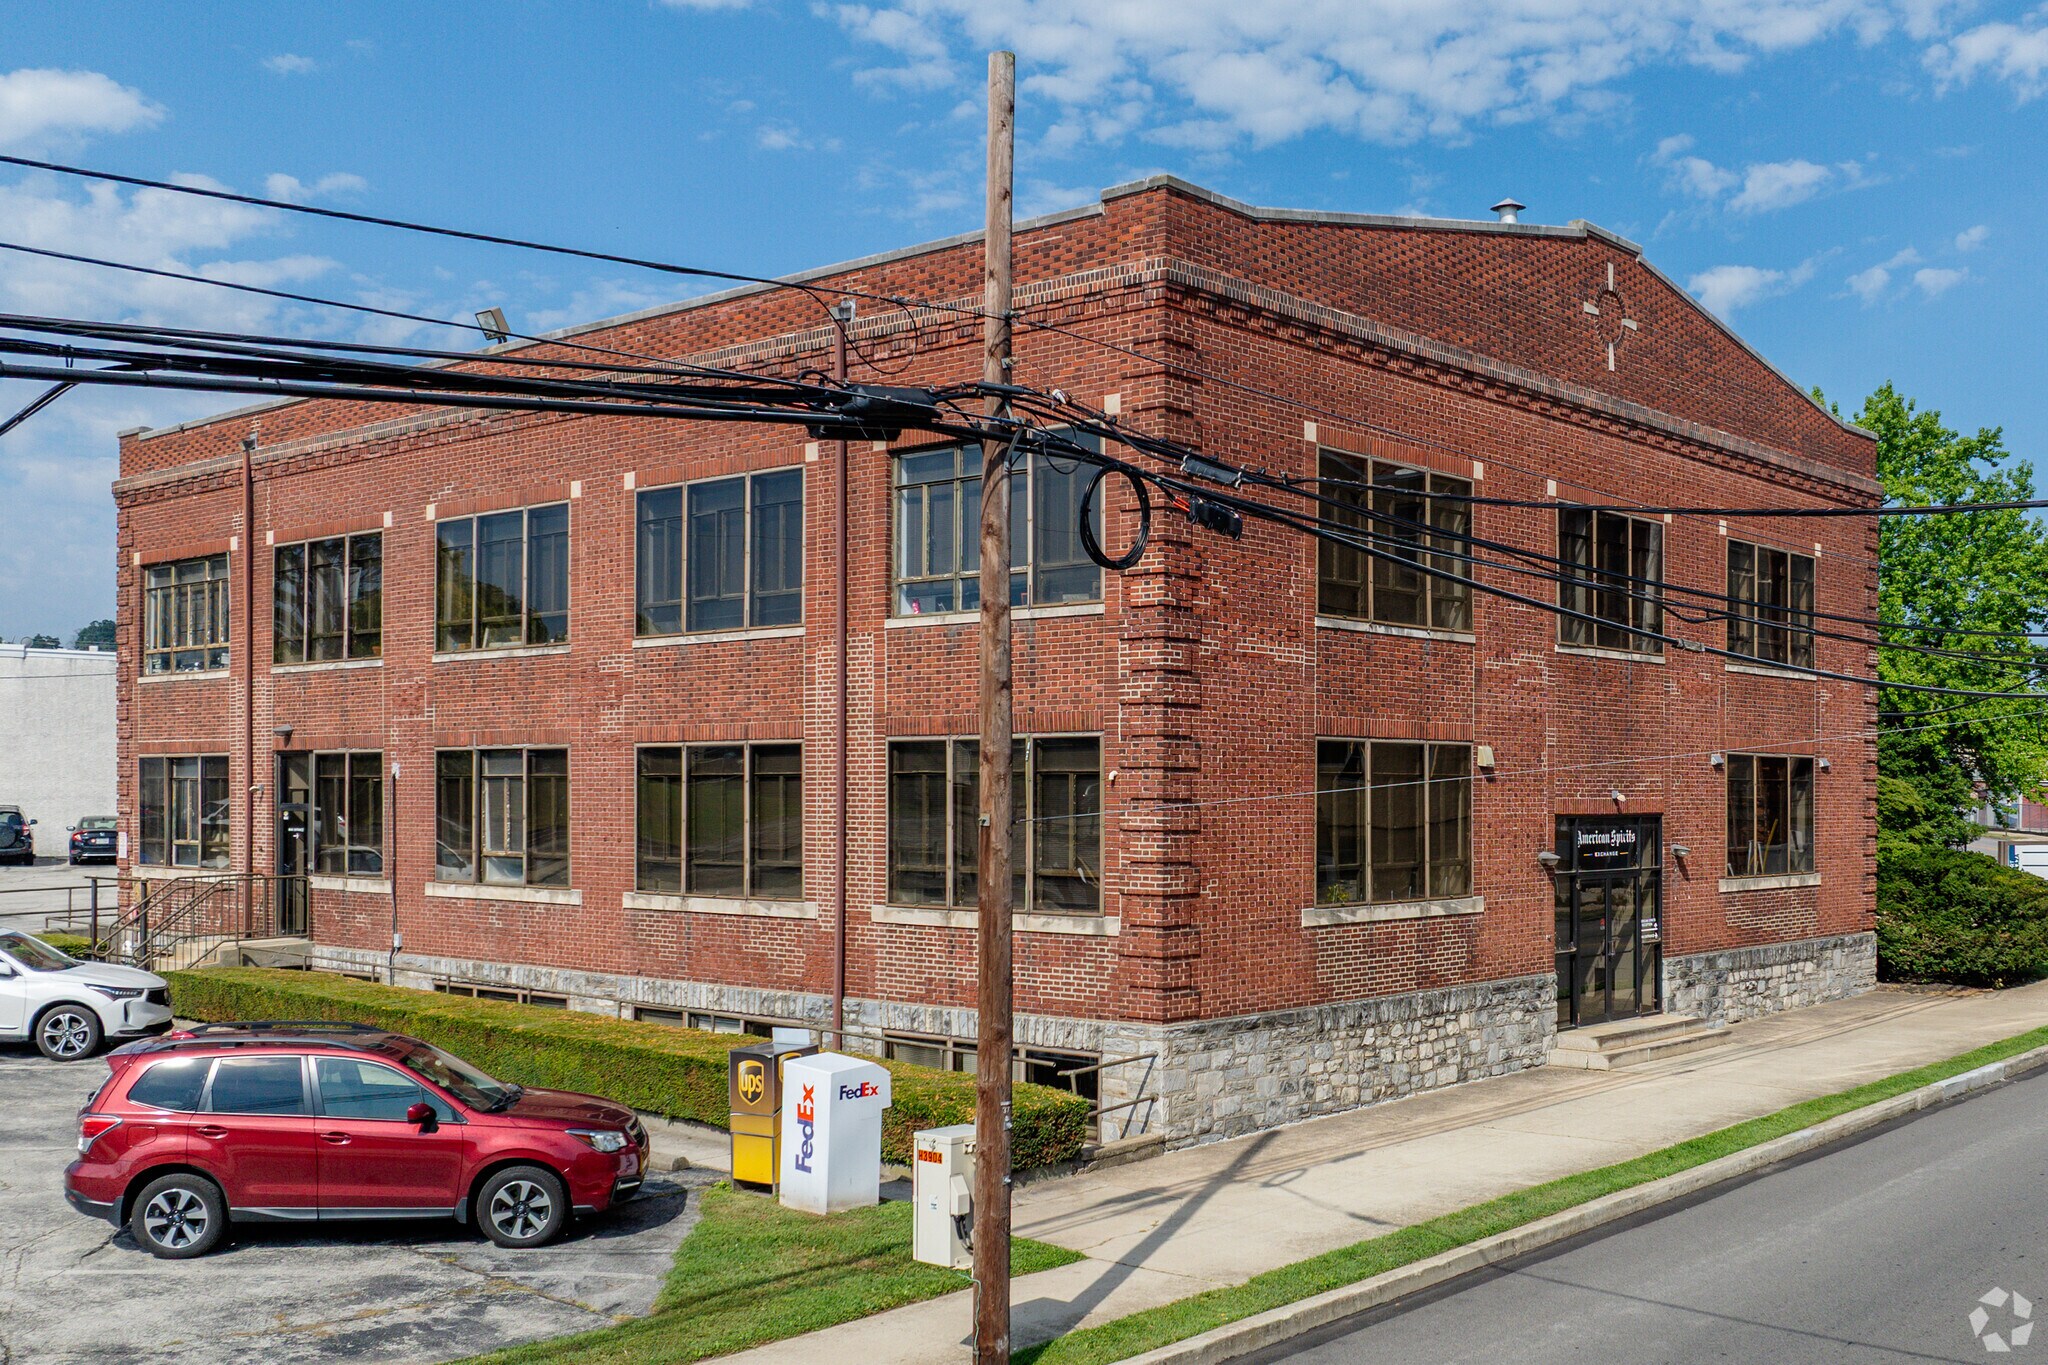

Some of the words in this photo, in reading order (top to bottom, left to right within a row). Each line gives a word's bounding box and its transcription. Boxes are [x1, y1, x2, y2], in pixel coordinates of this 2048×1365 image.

[1578, 830, 1610, 847] American
[1611, 829, 1635, 846] Spirits
[741, 1073, 763, 1099] ups
[839, 1081, 879, 1101] FedEx
[795, 1083, 815, 1174] FedEx
[918, 1150, 943, 1164] H3904
